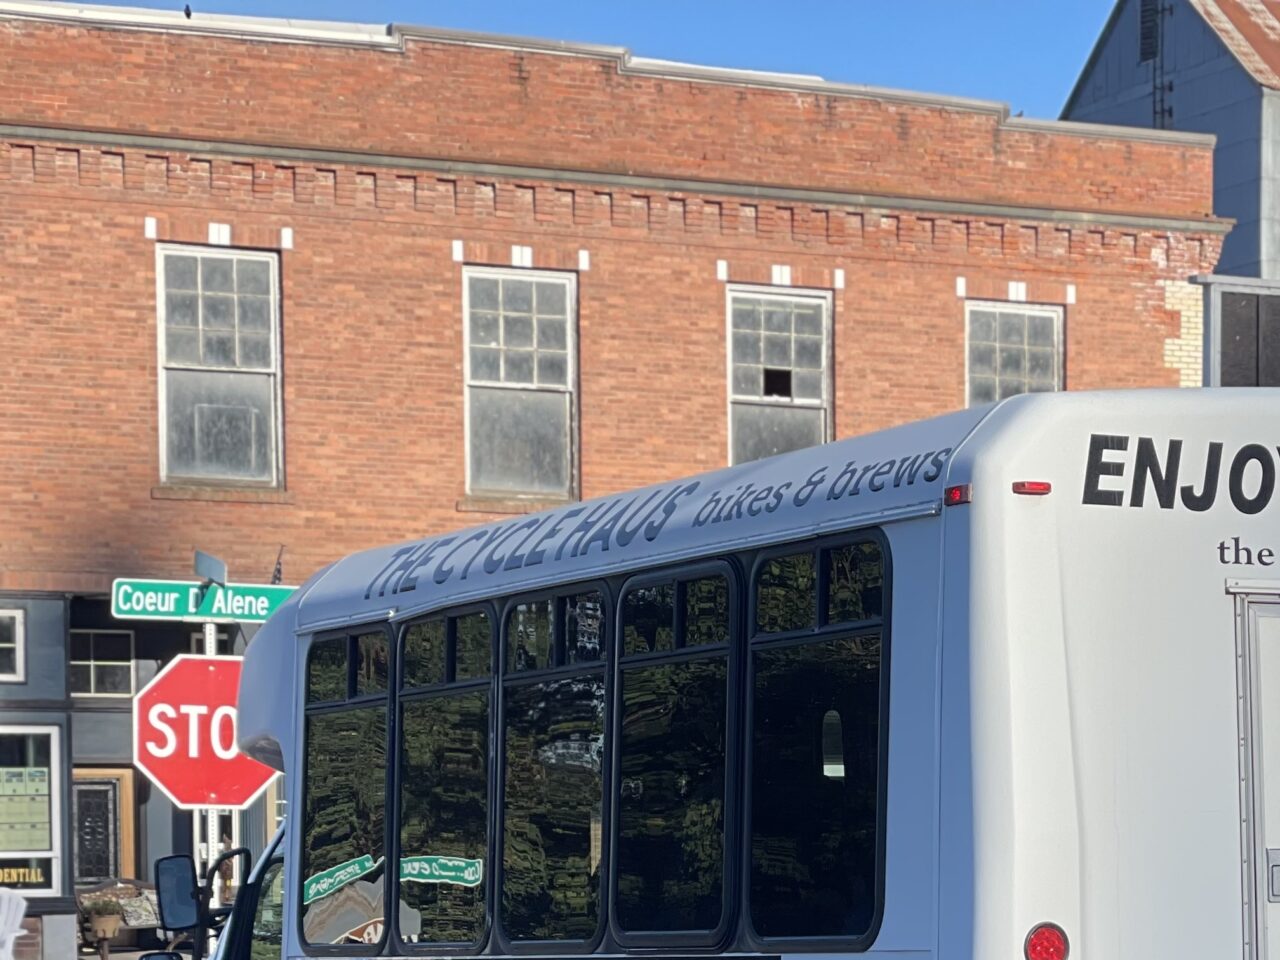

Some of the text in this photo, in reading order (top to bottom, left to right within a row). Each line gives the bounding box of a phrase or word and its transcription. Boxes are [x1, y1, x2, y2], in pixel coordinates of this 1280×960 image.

[363, 535, 460, 600] THE
[691, 478, 791, 528] bikes
[792, 465, 829, 508] &
[826, 447, 953, 501] brews
[1217, 537, 1275, 566] the
[118, 584, 181, 613] Coeur
[211, 589, 270, 616] Alene
[145, 702, 240, 761] STO
